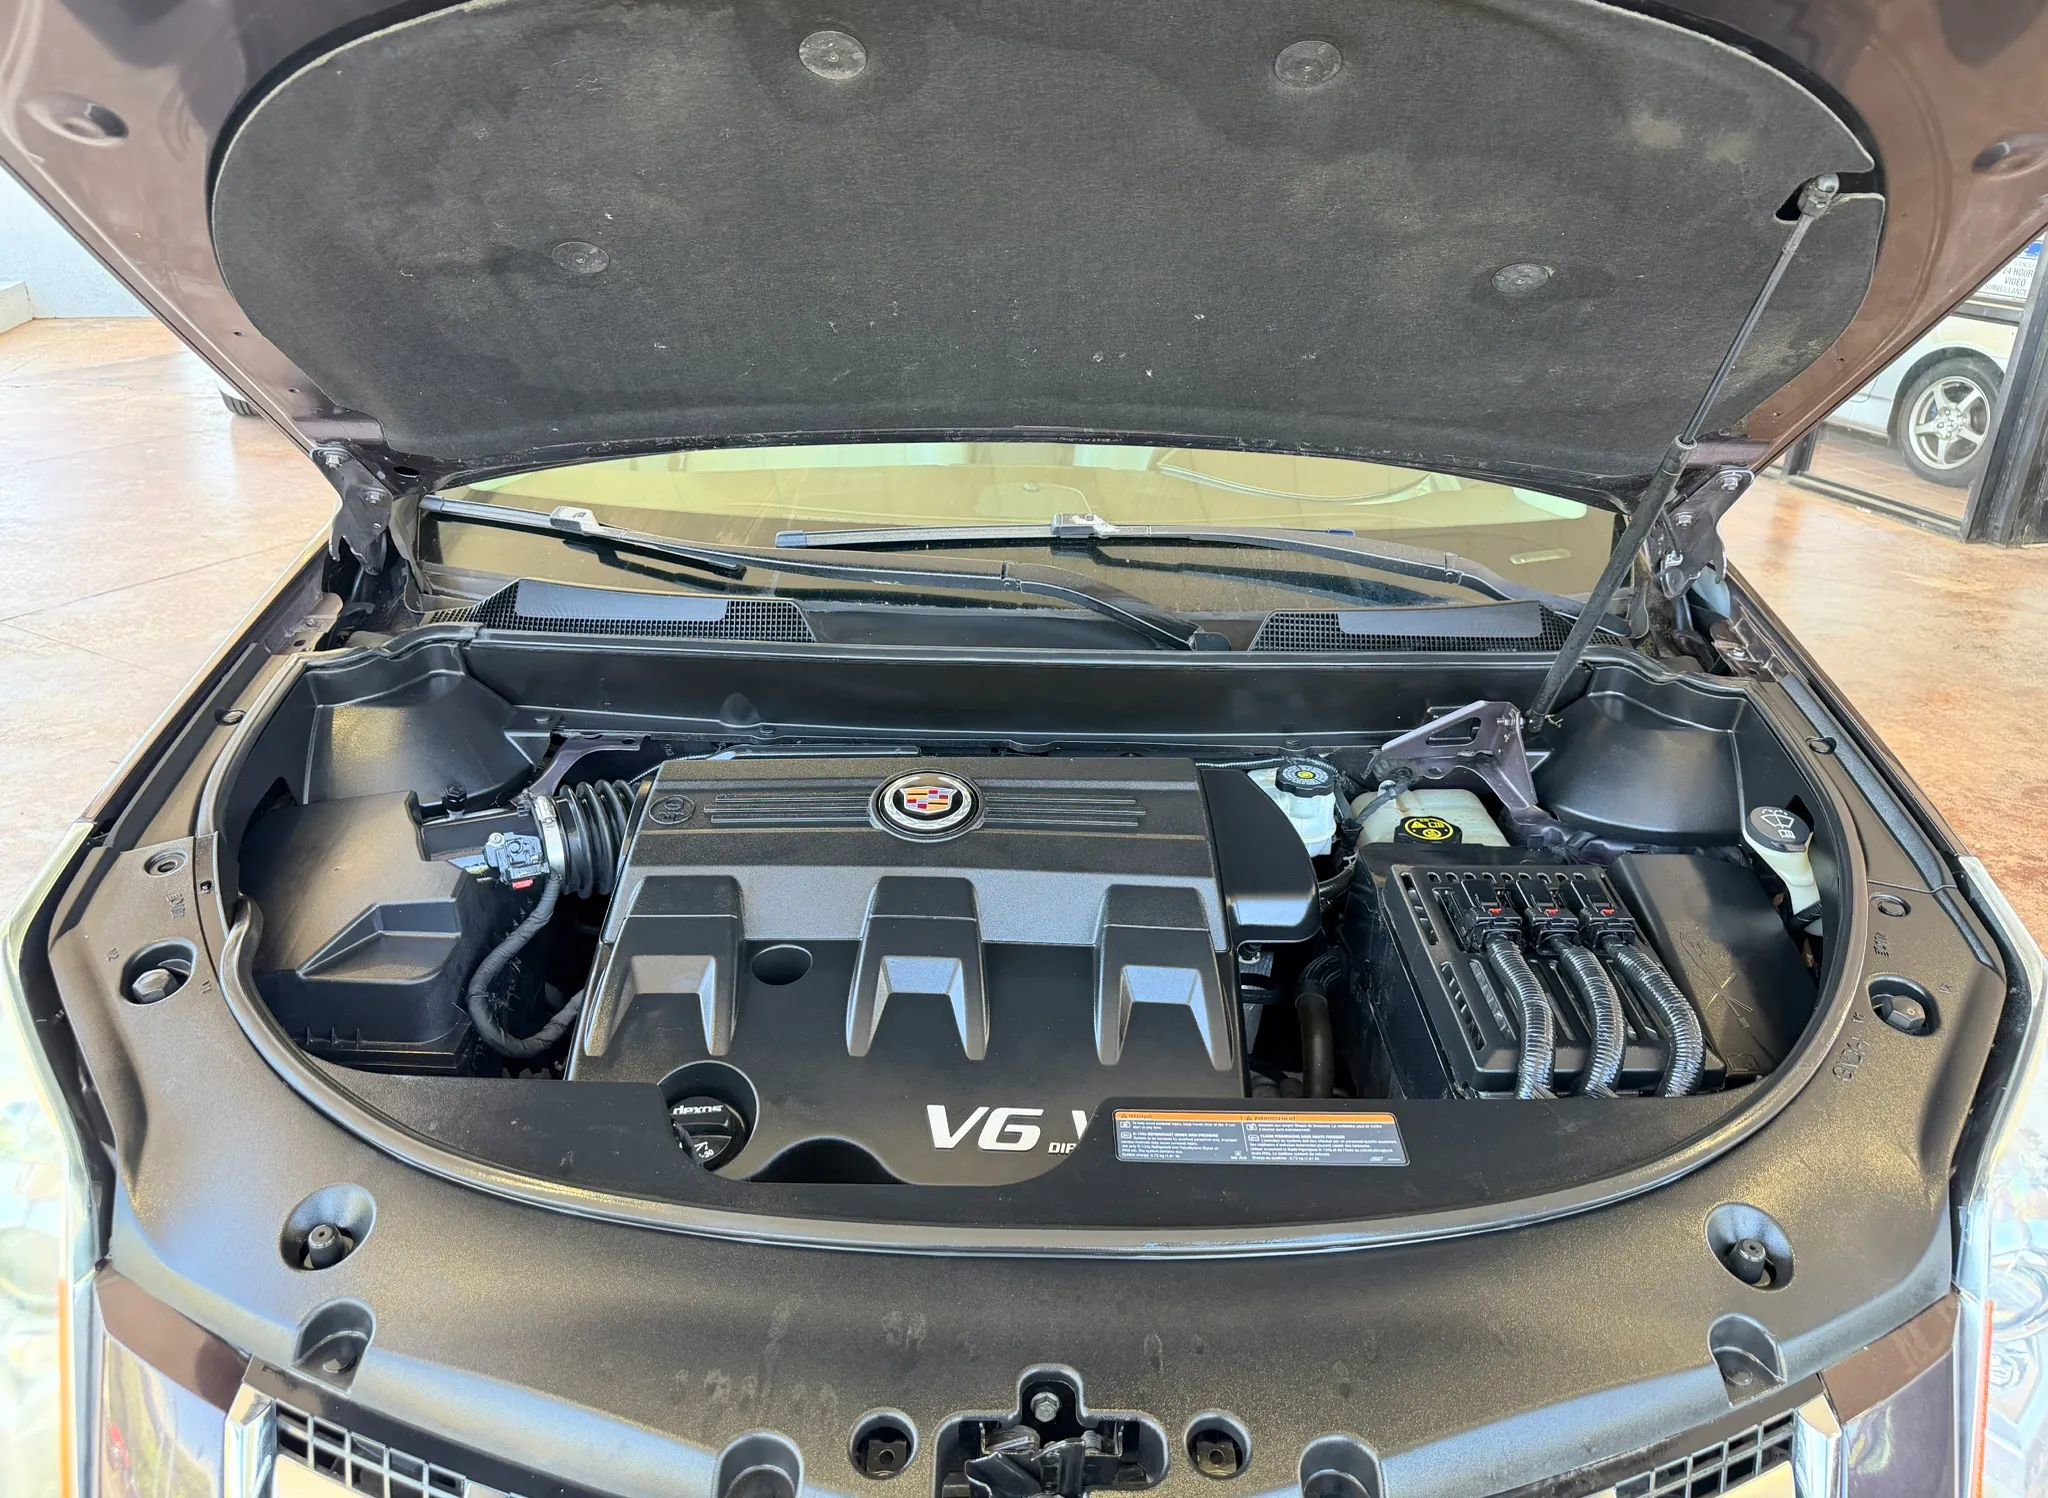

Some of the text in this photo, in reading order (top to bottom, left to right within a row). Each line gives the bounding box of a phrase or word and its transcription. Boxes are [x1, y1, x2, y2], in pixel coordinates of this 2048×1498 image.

[2013, 267, 2034, 278] HOUR
[2004, 276, 2026, 287] VIDEO
[1984, 284, 2027, 296] SURVEILLANCE
[926, 1104, 1044, 1152] V6
